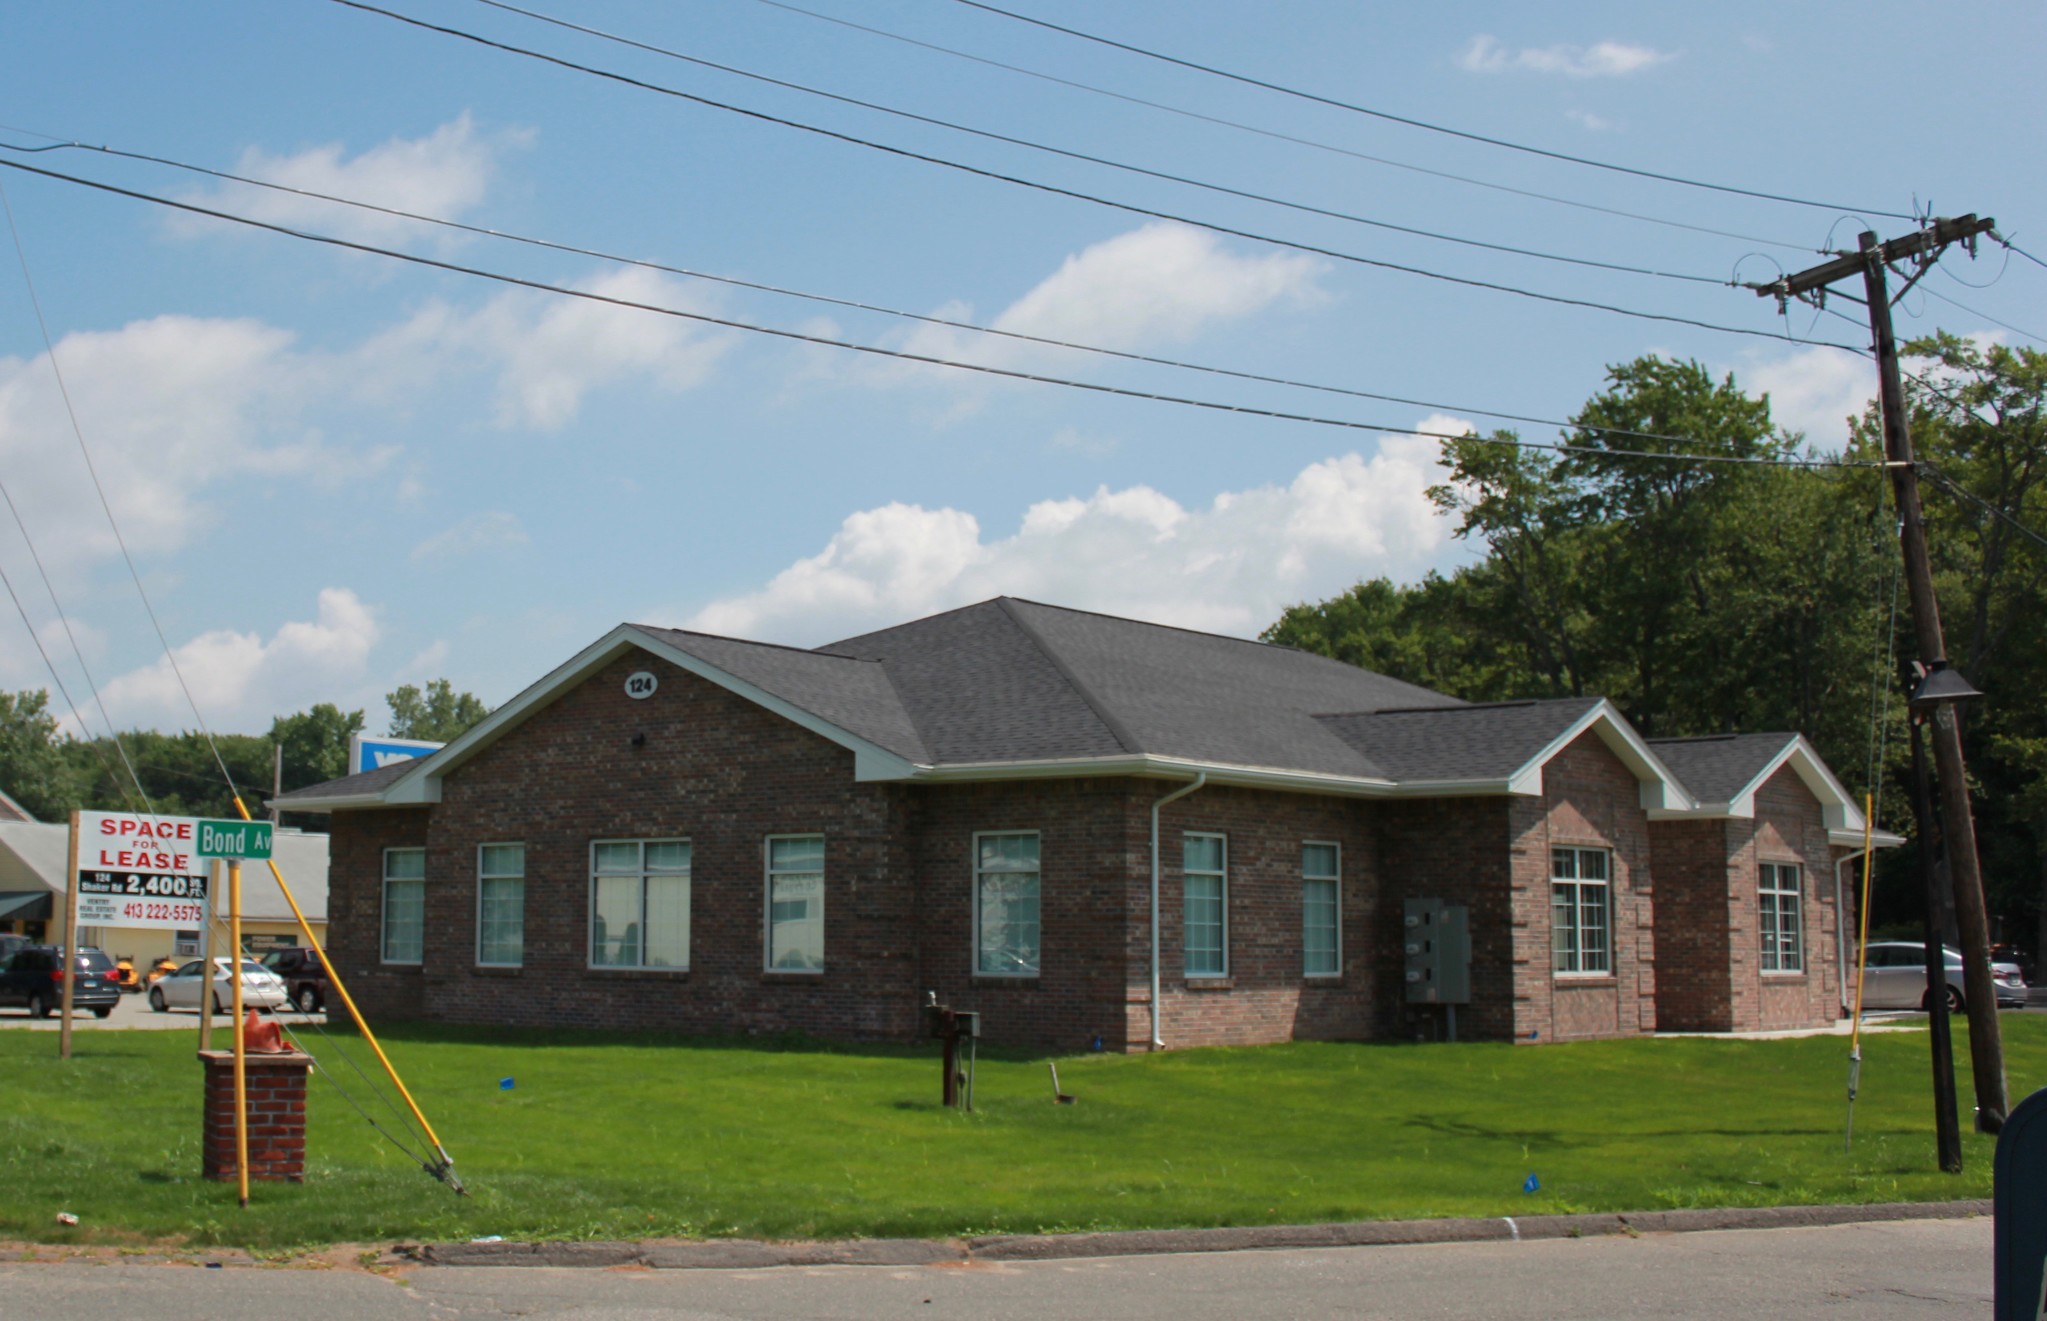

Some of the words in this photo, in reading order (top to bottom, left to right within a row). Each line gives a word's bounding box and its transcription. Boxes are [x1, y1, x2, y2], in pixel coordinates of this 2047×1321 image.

[630, 679, 651, 692] 124
[100, 820, 192, 839] SPACE
[132, 840, 158, 849] FOR
[203, 825, 245, 853] Bond
[100, 850, 188, 869] LEASE
[81, 882, 110, 892] Shaker
[111, 884, 122, 892] Rd
[95, 874, 110, 882] 124
[127, 875, 187, 896] 2,400
[124, 903, 143, 918] 413
[147, 904, 202, 921] 222-5575
